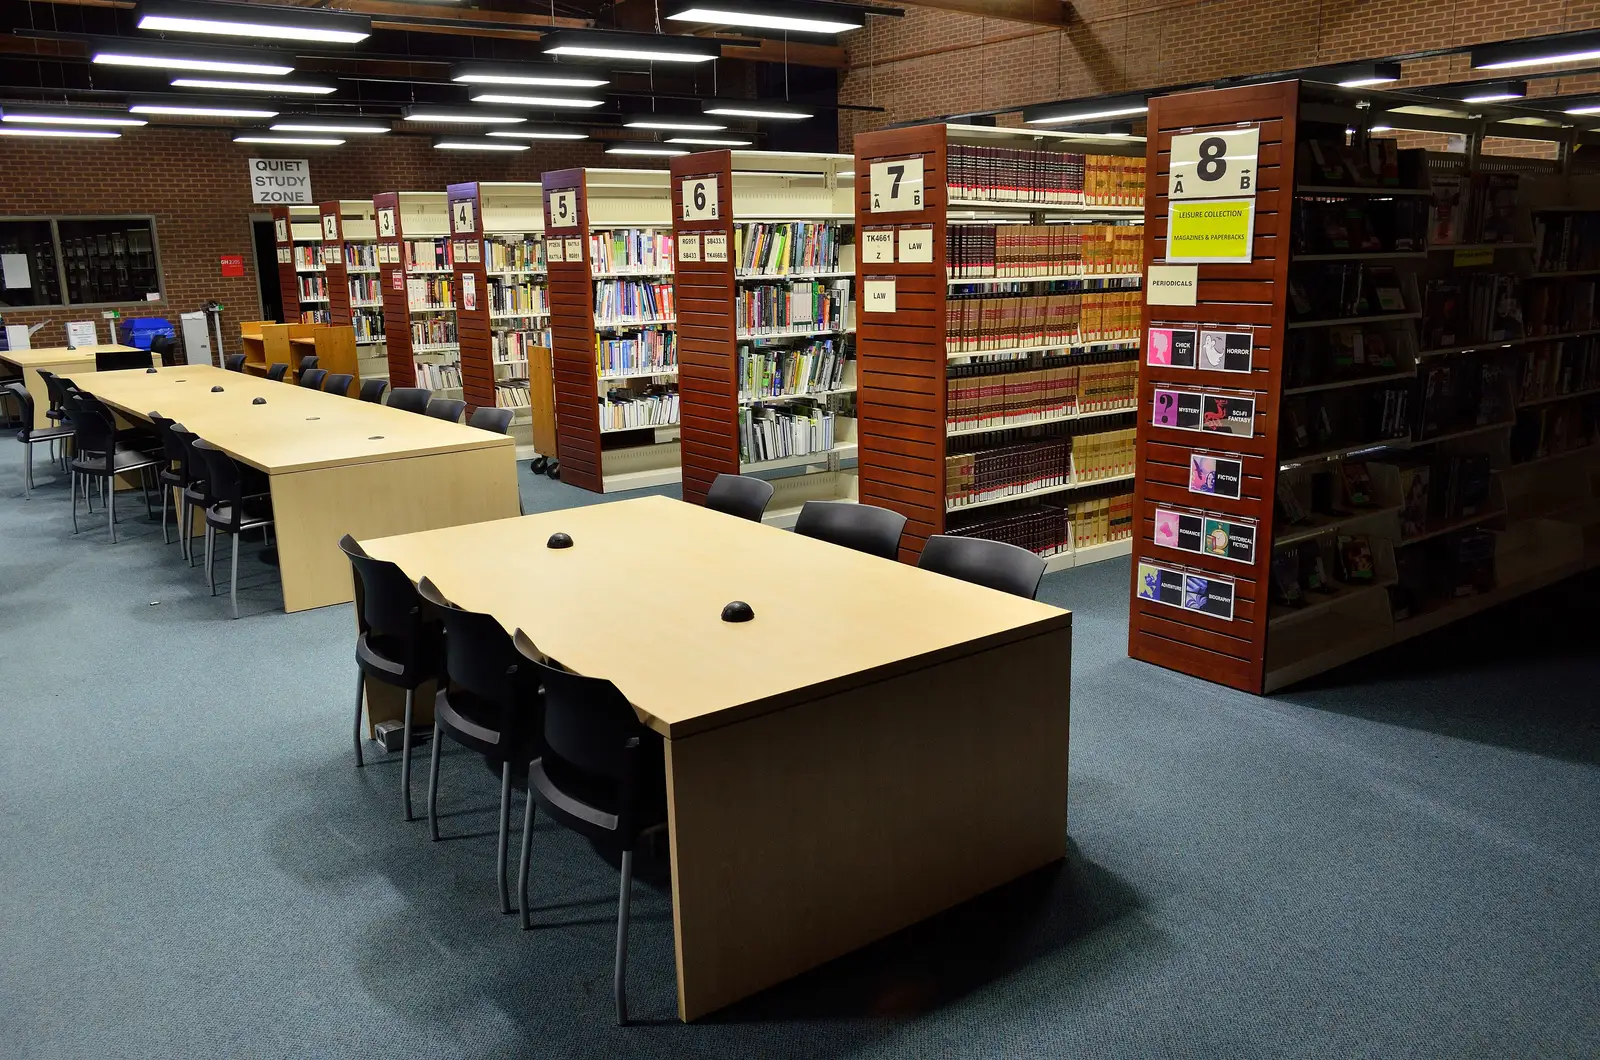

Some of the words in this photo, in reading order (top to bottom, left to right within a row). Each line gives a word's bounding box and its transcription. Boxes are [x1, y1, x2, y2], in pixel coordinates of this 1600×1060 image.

[1196, 136, 1227, 182] 8
[255, 160, 303, 172] QUIET
[255, 176, 306, 187] STUDY
[887, 165, 905, 199] 7
[1239, 176, 1251, 190] B
[1173, 180, 1184, 194] A
[260, 192, 304, 202] ZONE
[693, 182, 706, 211] 6
[913, 194, 921, 206] B
[558, 195, 568, 219] 5
[874, 198, 881, 209] A
[459, 205, 467, 226] 4
[685, 209, 690, 218] A
[711, 207, 716, 216] B
[1179, 211, 1203, 219] LEISURE
[1203, 209, 1243, 218] COLLECTION
[327, 218, 333, 235] 2
[383, 212, 390, 231] 3
[279, 221, 284, 237] 1
[867, 234, 891, 242] TK4661
[1210, 233, 1245, 241] PAPERBACKS
[908, 242, 922, 250] LAW
[876, 252, 881, 260] Z
[873, 292, 887, 300] LAW
[1175, 341, 1191, 349] CHICK
[1178, 406, 1200, 415] MYSTERY
[1227, 416, 1252, 424] FANTASY
[1217, 473, 1238, 483] FICTION
[1180, 528, 1201, 537] ROMANCE
[1229, 534, 1253, 544] HISTORICAL
[1232, 541, 1249, 550] FICTION
[1160, 581, 1182, 592] ADVENTURE
[1208, 593, 1232, 604] BIOGRAPHY
